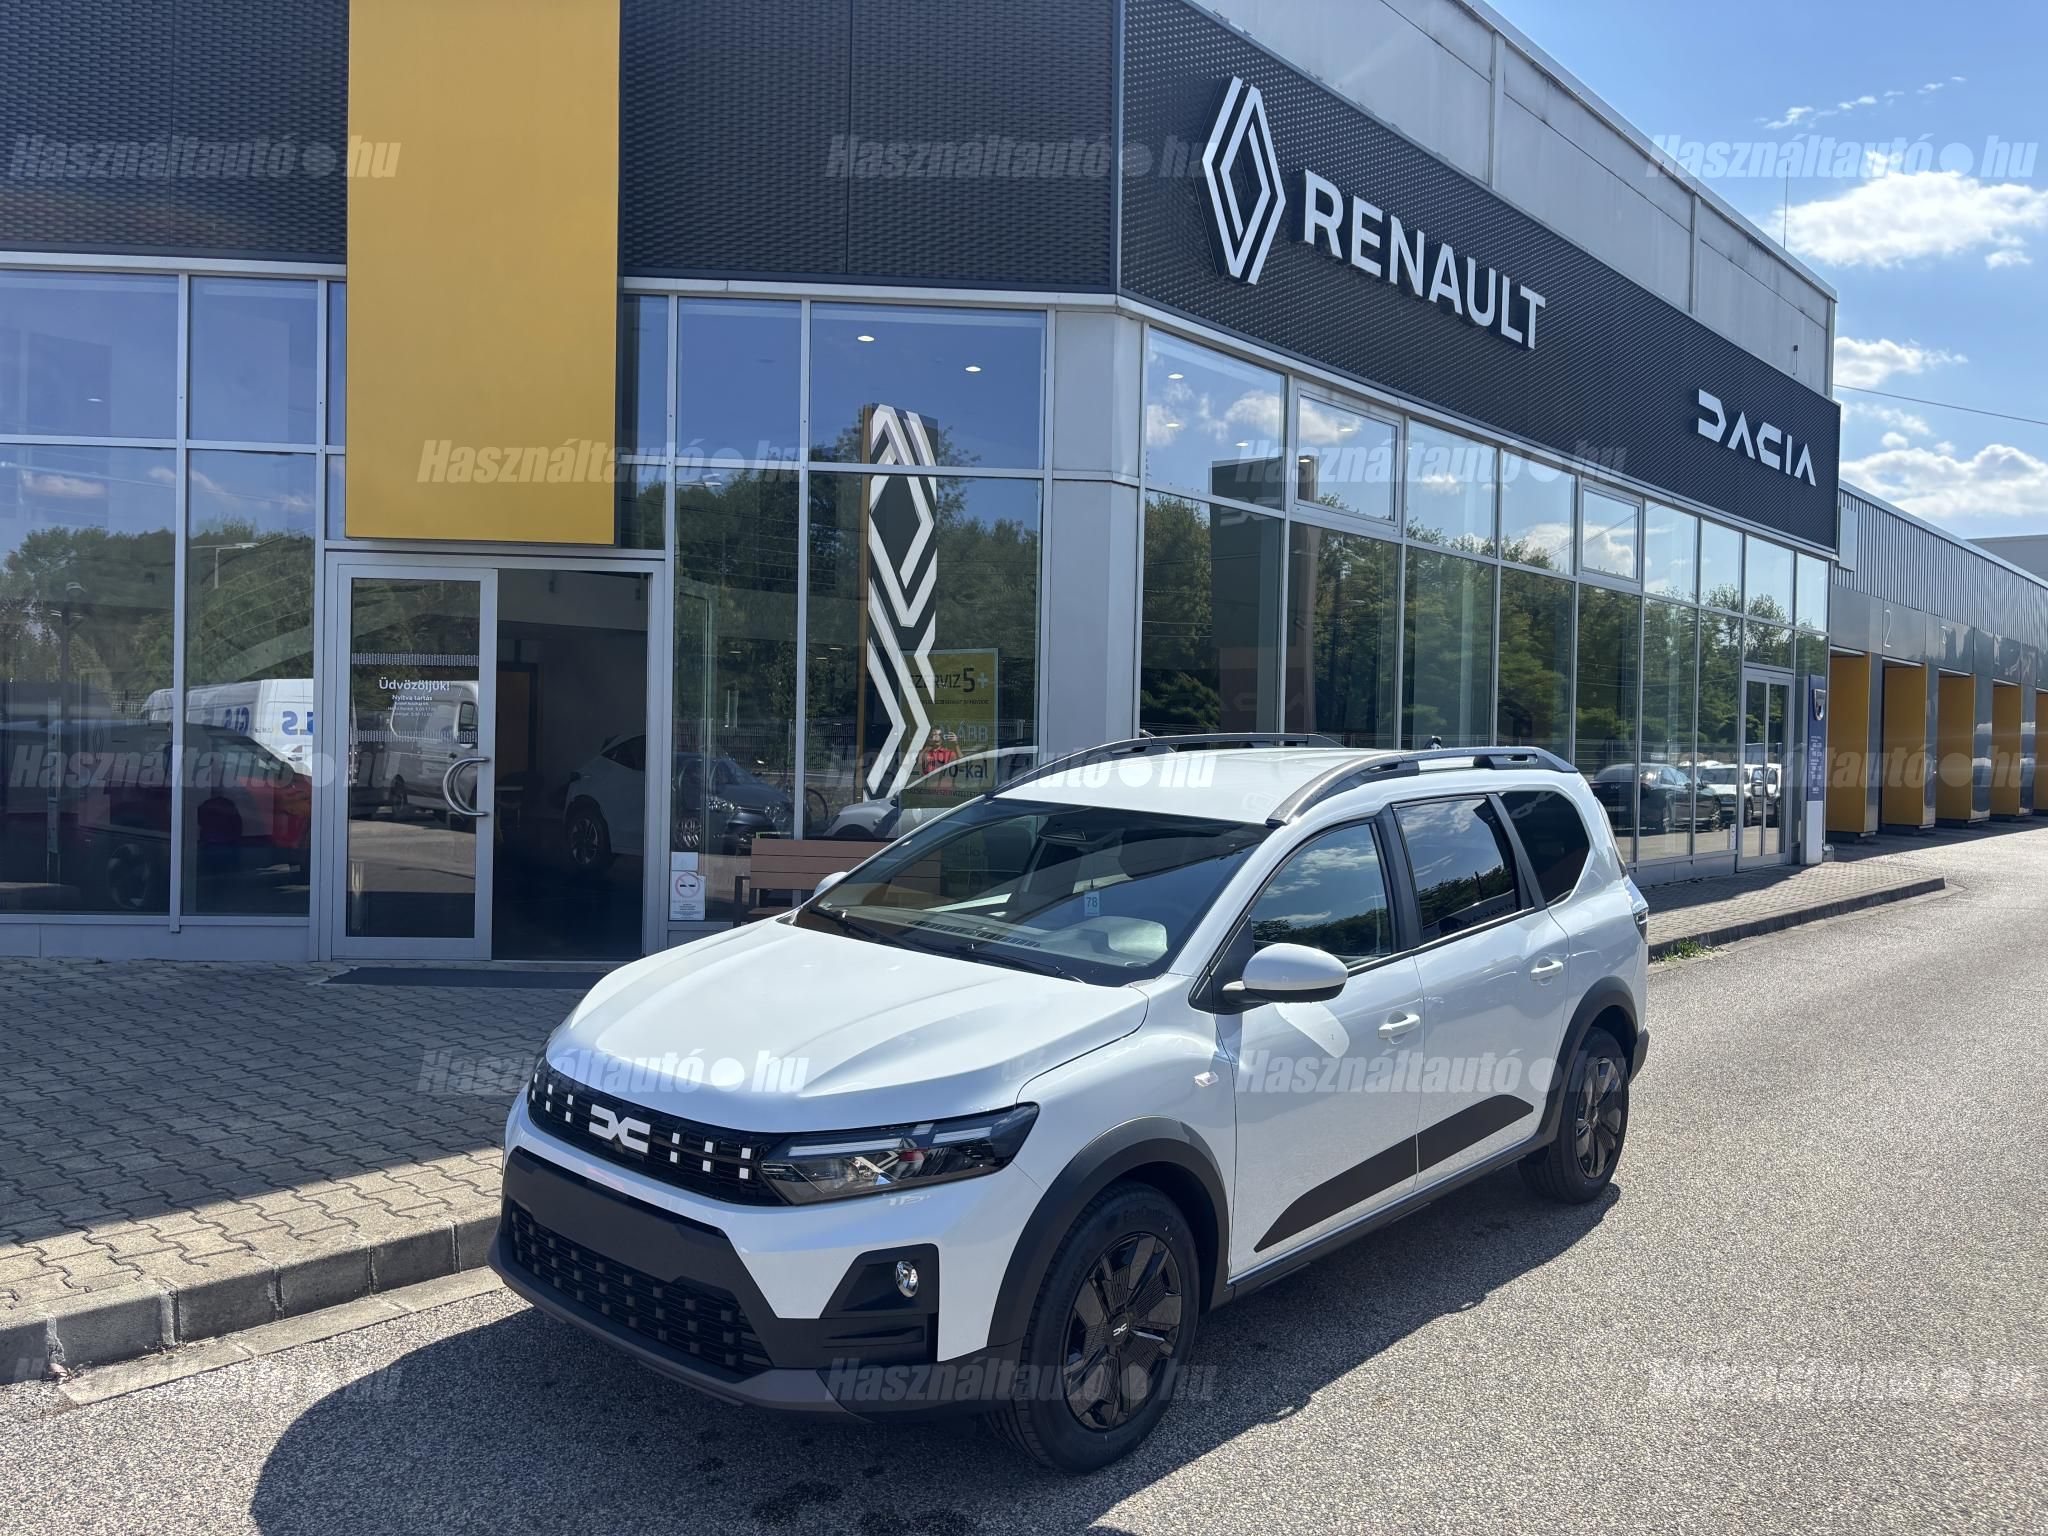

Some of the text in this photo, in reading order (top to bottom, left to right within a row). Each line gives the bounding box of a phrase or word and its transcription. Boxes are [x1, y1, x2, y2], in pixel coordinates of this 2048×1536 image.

[1304, 168, 1546, 350] RENAULT
[1697, 388, 1817, 487] DACIA
[378, 676, 451, 693] Üdvözöljük!
[1085, 896, 1098, 908] 78
